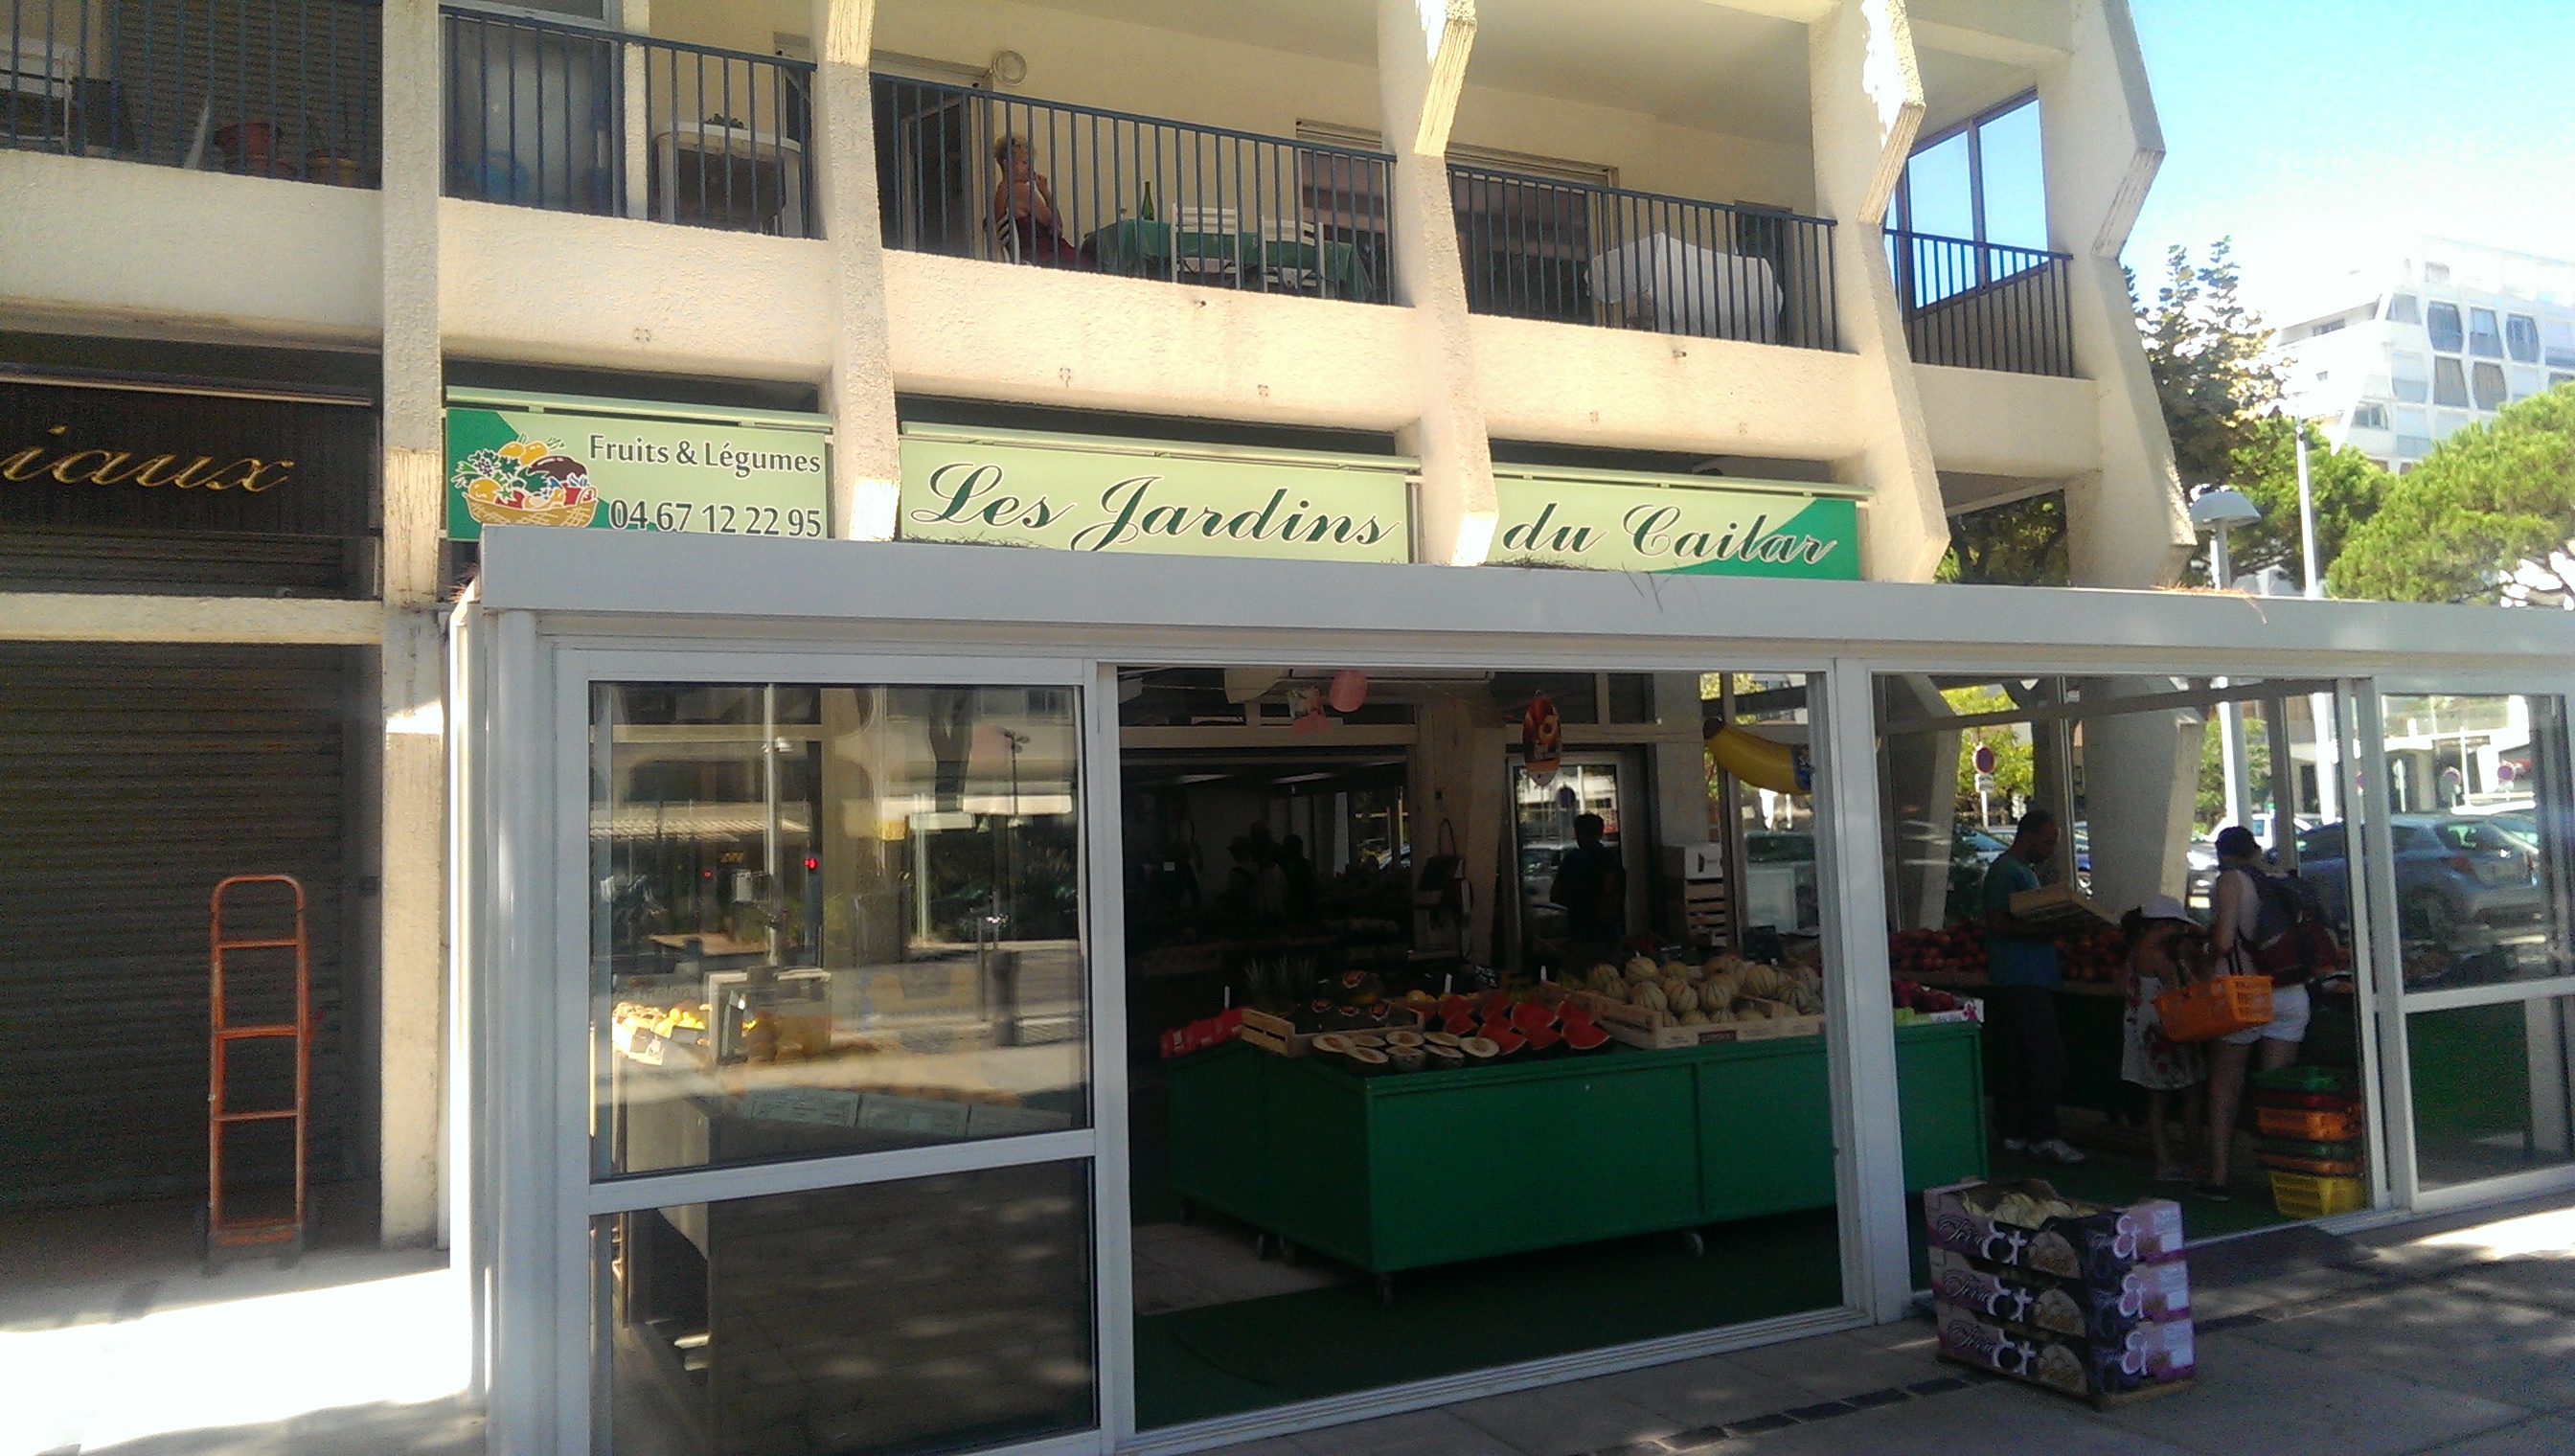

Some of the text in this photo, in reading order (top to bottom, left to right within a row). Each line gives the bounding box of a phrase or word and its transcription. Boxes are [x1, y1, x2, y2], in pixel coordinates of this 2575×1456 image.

[589, 434, 822, 478] Fruits & Légumes
[609, 499, 822, 537] 04 67 12 22 95
[910, 463, 1837, 565] Les Jardins du Cailar
